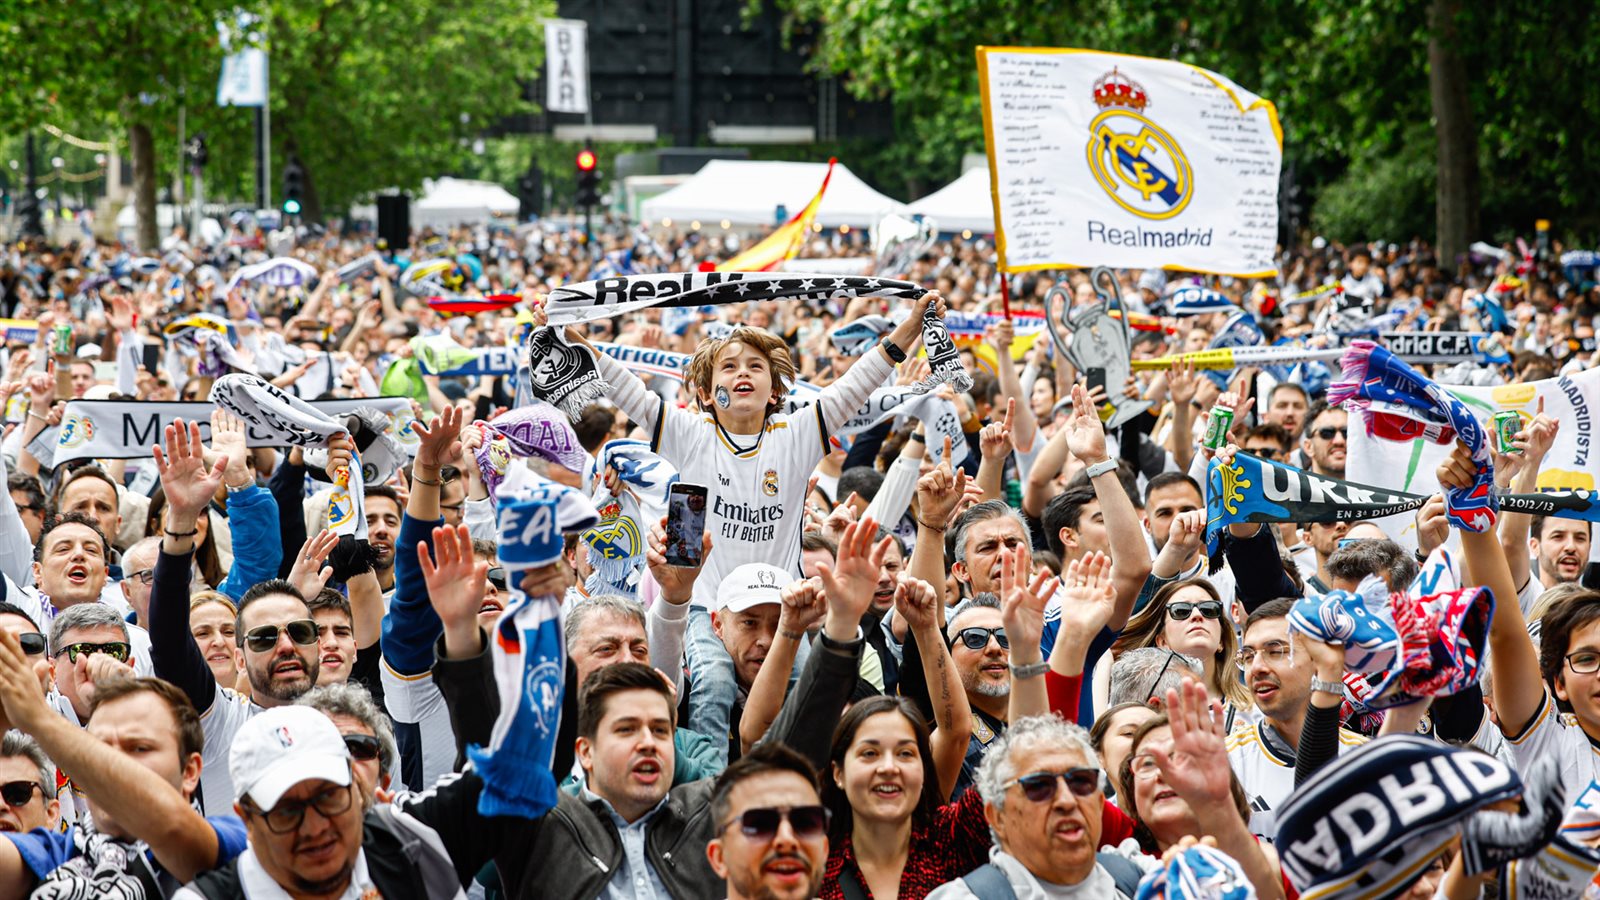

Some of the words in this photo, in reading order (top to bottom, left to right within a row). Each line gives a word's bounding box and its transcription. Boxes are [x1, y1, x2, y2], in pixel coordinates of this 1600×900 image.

[558, 30, 575, 107] BAR
[1087, 220, 1213, 248] Realmadrid
[594, 273, 693, 306] Real
[1557, 375, 1591, 466] MADRIDISTA
[713, 495, 784, 525] Emirates
[1336, 509, 1352, 519] EN
[1509, 497, 1554, 512] 2012/13
[721, 522, 739, 539] FLY
[740, 524, 774, 543] BETTER
